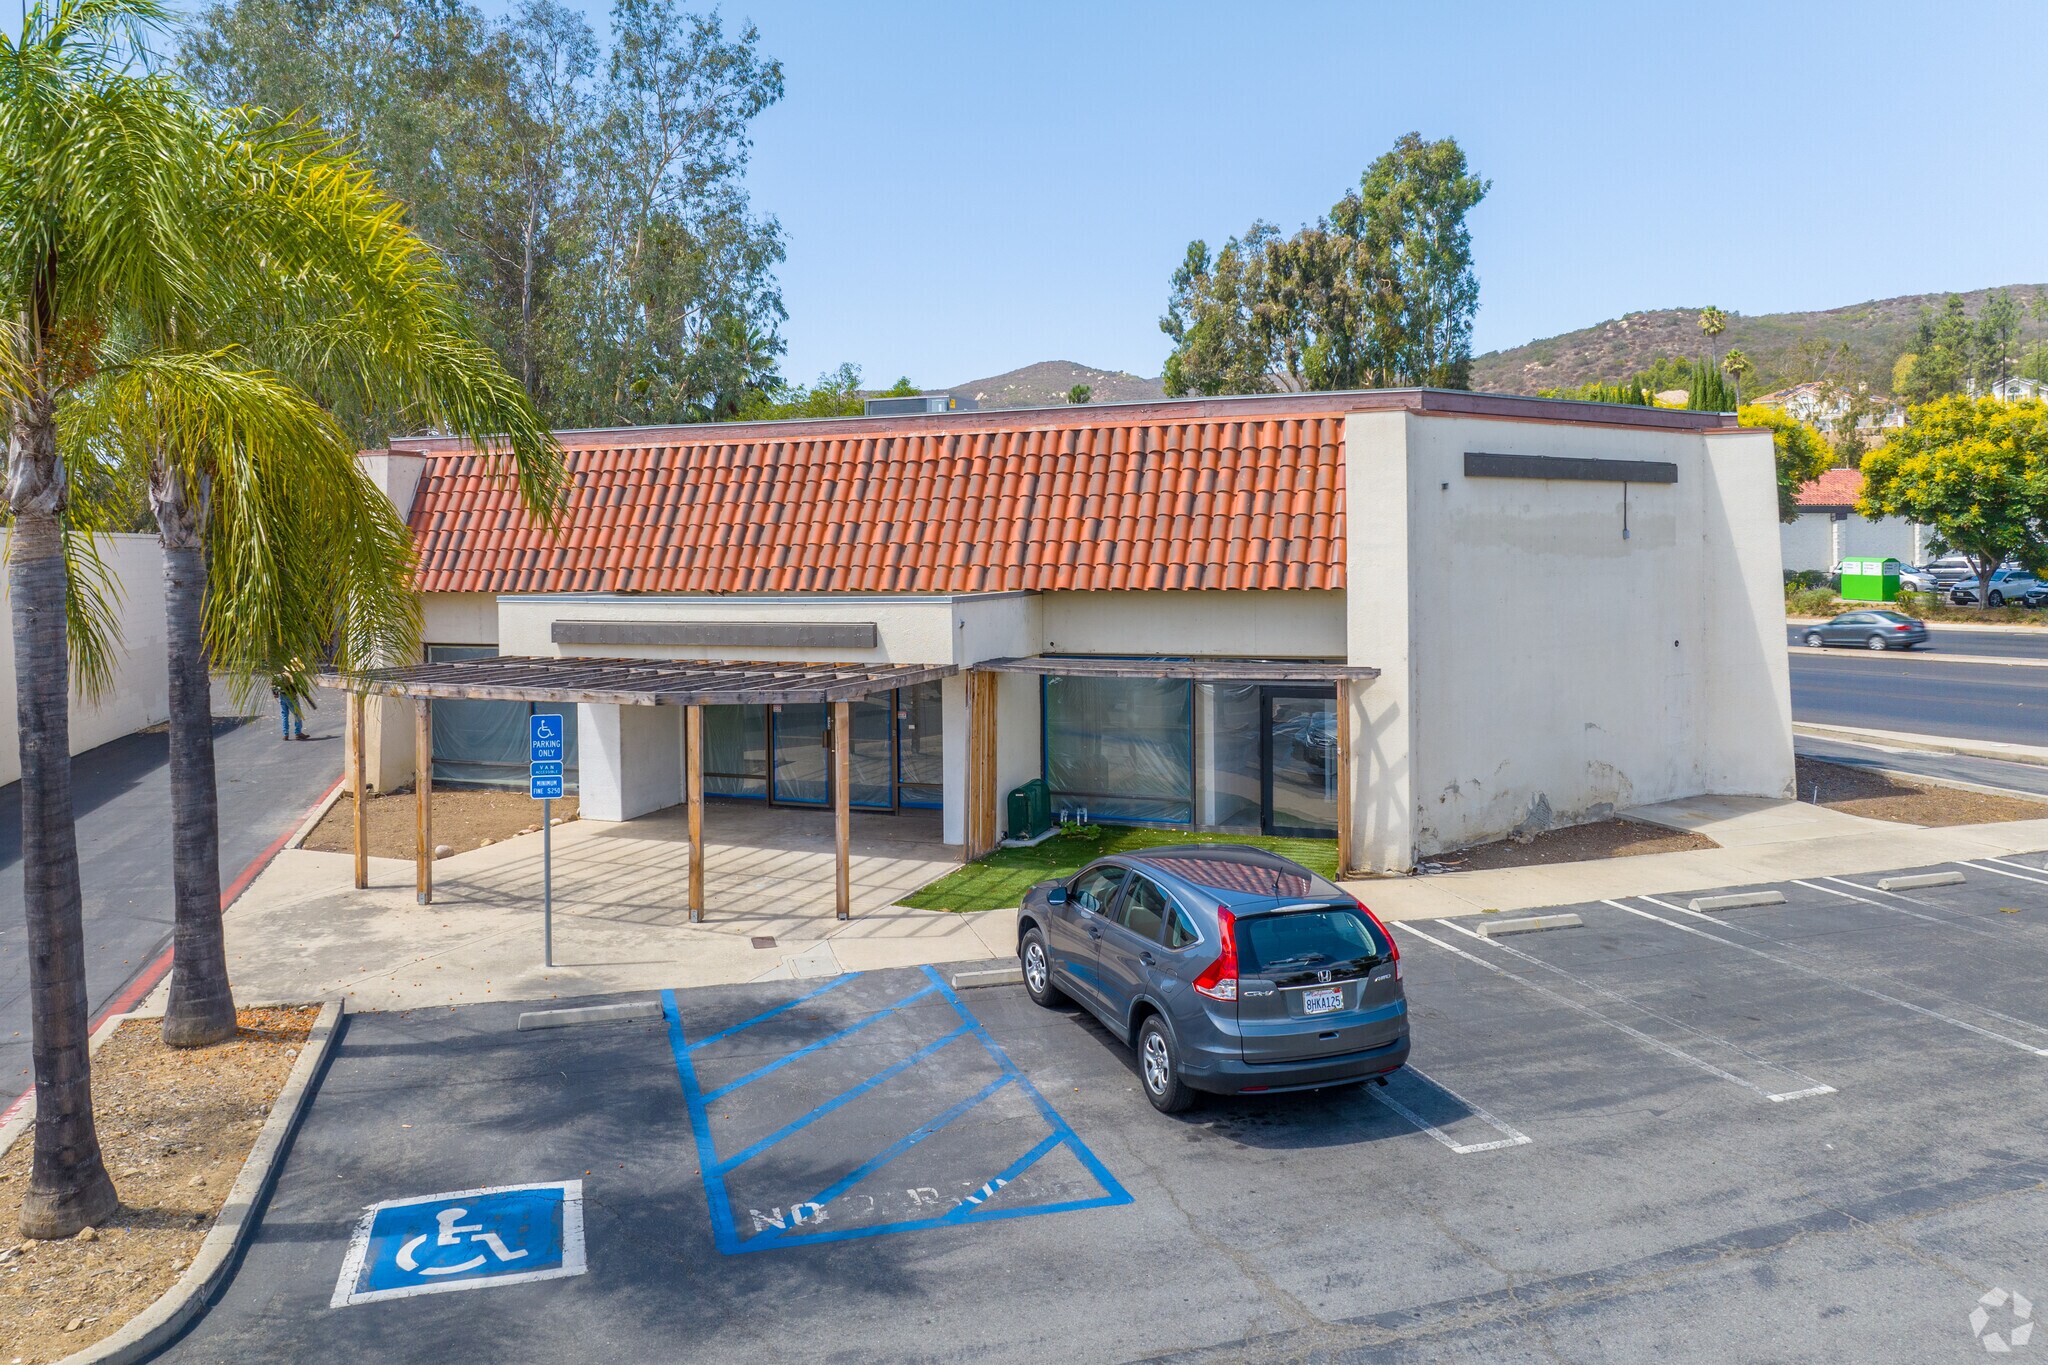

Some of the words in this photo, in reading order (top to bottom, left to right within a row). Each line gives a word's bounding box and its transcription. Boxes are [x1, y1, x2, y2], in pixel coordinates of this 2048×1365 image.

[533, 740, 561, 748] PARKING
[538, 749, 555, 757] ONLY
[1374, 974, 1392, 982] AWD
[1311, 989, 1334, 998] California
[1306, 998, 1341, 1011] 8HKA125
[749, 1202, 830, 1232] NO
